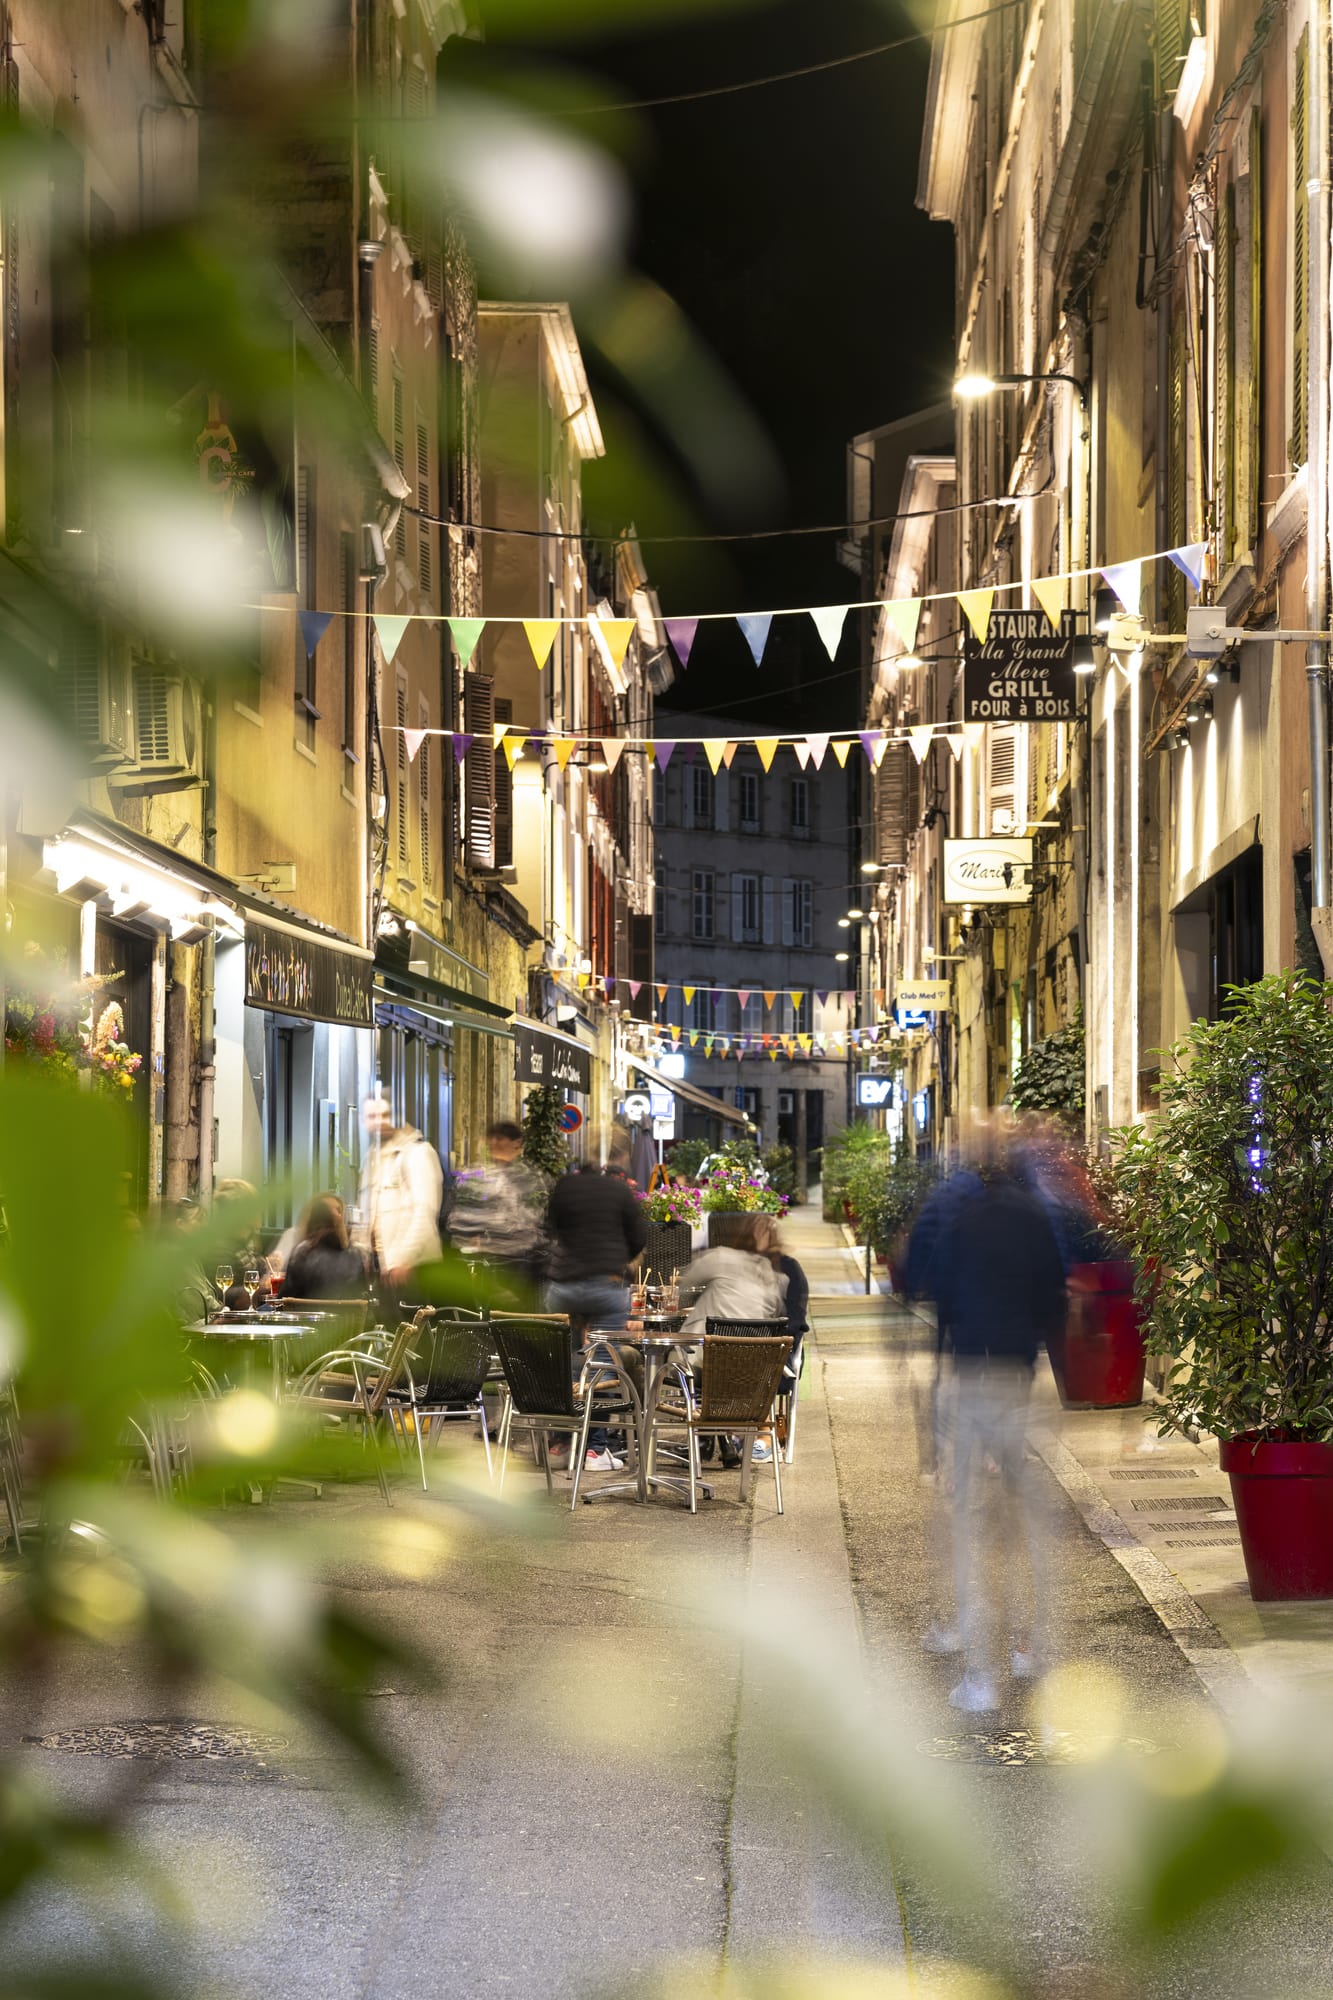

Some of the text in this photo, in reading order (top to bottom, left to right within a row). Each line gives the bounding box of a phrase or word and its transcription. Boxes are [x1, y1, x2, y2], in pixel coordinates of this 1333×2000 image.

[969, 639, 1070, 660] Ma Grand
[991, 659, 1050, 680] Mere
[988, 680, 1054, 698] GRILL
[971, 699, 1070, 716] FOUR à BOIS
[900, 992, 936, 1000] Club Med
